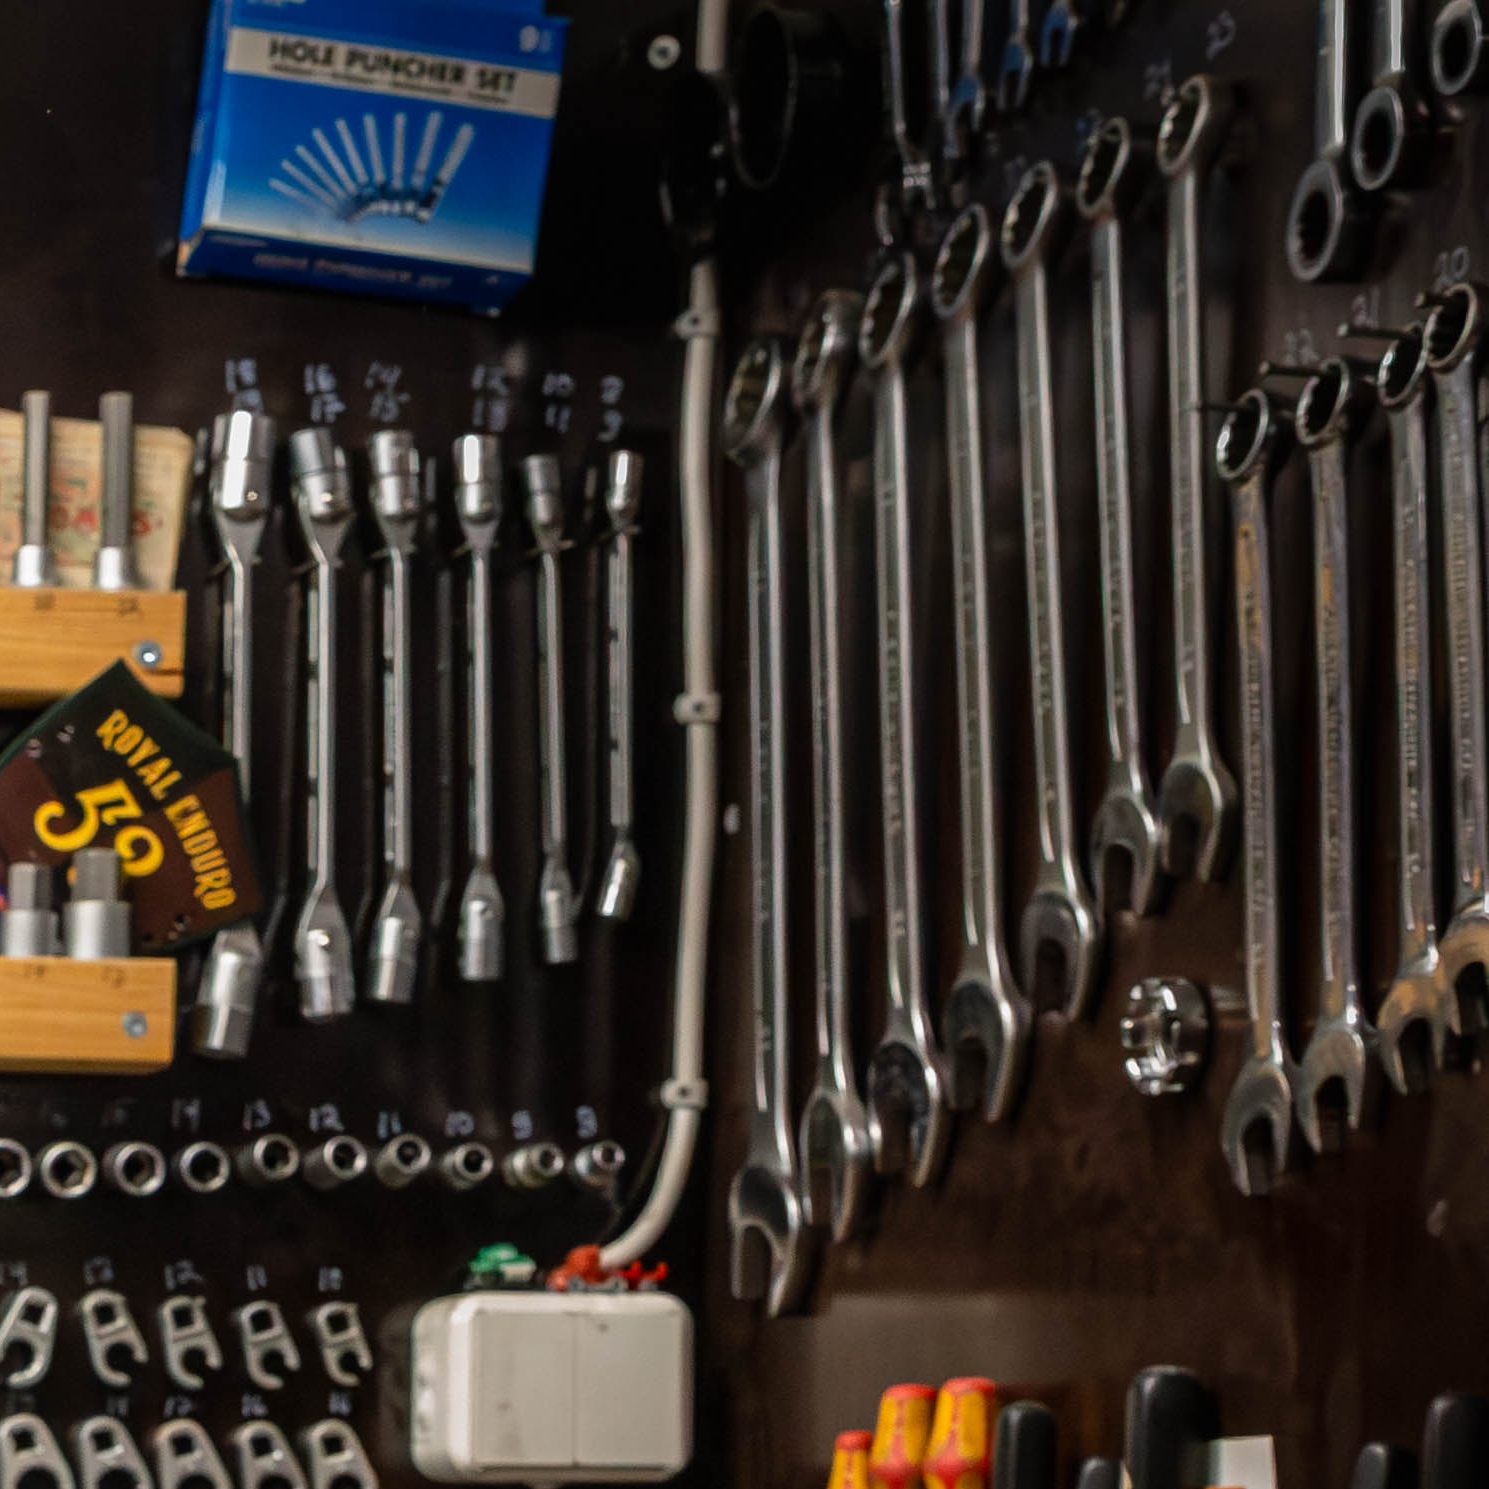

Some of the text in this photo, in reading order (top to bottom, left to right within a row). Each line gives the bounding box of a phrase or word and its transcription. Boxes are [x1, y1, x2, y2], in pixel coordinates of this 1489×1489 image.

[268, 38, 334, 67] HOLE
[344, 48, 467, 85] PUNCHER
[477, 67, 517, 94] SET
[96, 709, 236, 911] ROYAL ENDURO
